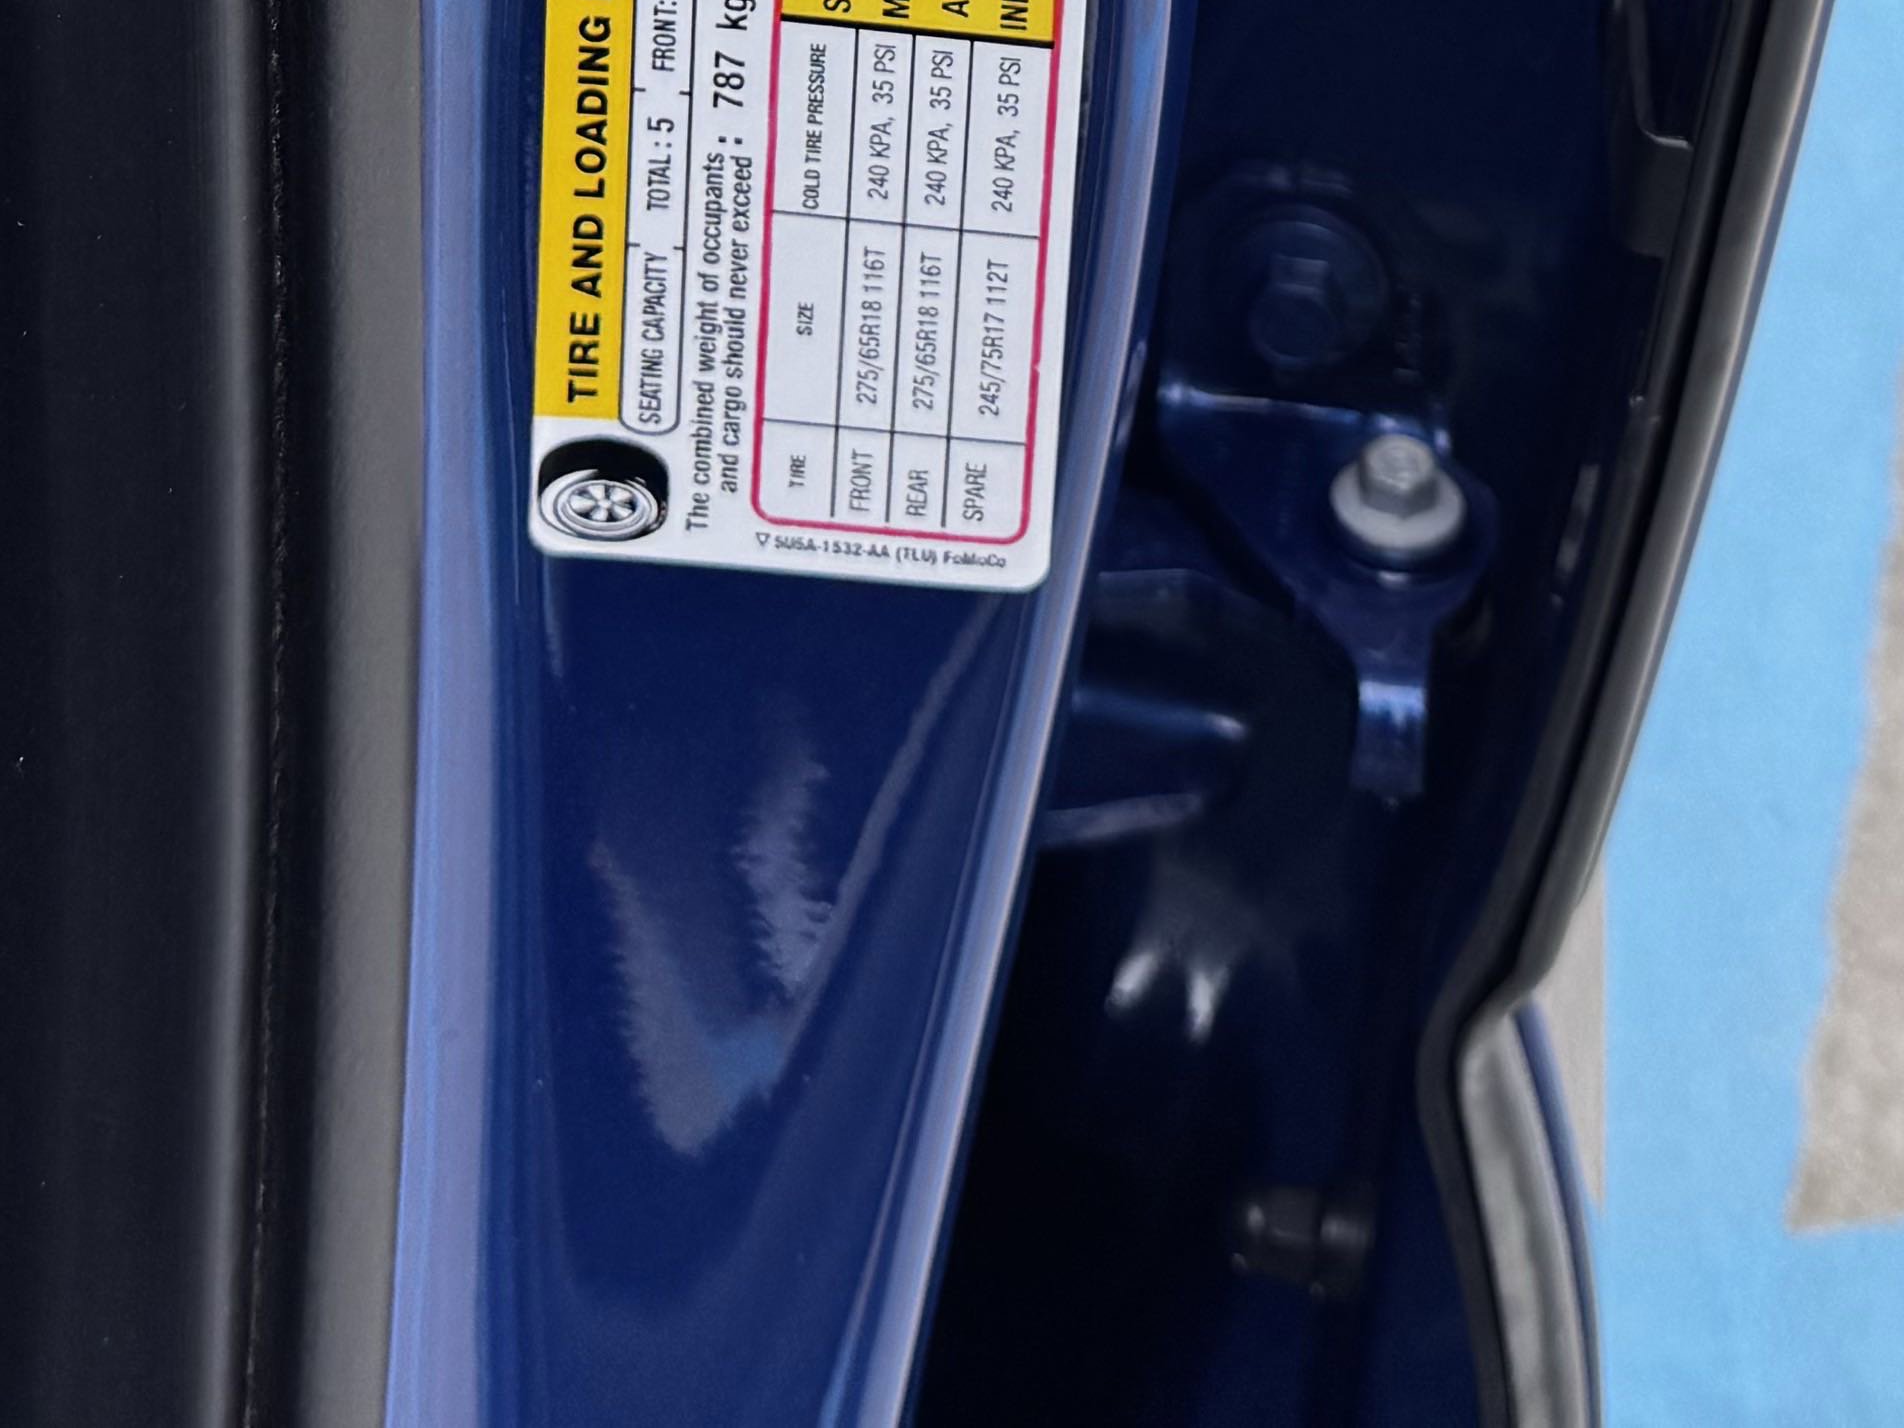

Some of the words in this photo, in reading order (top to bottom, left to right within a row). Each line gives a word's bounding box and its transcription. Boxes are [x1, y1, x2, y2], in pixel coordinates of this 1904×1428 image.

[652, 0, 677, 72] FRONT:
[873, 44, 896, 73] PSI
[712, 51, 745, 109] 787
[806, 43, 827, 125] PRESSURE
[931, 50, 954, 79] PSI
[998, 57, 1021, 86] PSI
[573, 16, 611, 198] LOADING
[871, 80, 894, 105] 35
[929, 86, 952, 110] 35
[997, 92, 1019, 117] 35
[804, 130, 823, 163] TIRE
[869, 117, 895, 159] KPA,
[927, 123, 953, 165] KPA,
[994, 130, 1021, 171] KPA,
[647, 154, 671, 211] TOTAL
[730, 156, 752, 232] exceed
[802, 169, 821, 210] COLD
[867, 165, 890, 200] 240
[924, 171, 947, 206] 240
[991, 177, 1014, 213] 240
[701, 153, 727, 265] occupants
[570, 214, 603, 298] AND
[728, 239, 748, 299] never
[862, 246, 886, 292] 116T
[918, 251, 942, 298] 116T
[641, 251, 667, 342] CAPACITY
[697, 272, 719, 292] of
[985, 259, 1009, 305] 112T
[696, 302, 722, 372] weight
[795, 302, 814, 336] SIZE
[567, 312, 600, 403] TIRE
[722, 308, 746, 379] should
[856, 300, 884, 404] 275/65R18
[912, 306, 940, 411] 275/65R18
[978, 312, 1006, 417] 245/75R17
[638, 349, 664, 424] SEATING
[690, 381, 715, 485] combined
[721, 386, 746, 446] cargo
[717, 454, 738, 493] and
[788, 454, 806, 488] TIRE
[849, 448, 874, 512] FRONT
[905, 469, 928, 517] REAR
[962, 462, 987, 522] SPARE
[686, 493, 709, 531] The
